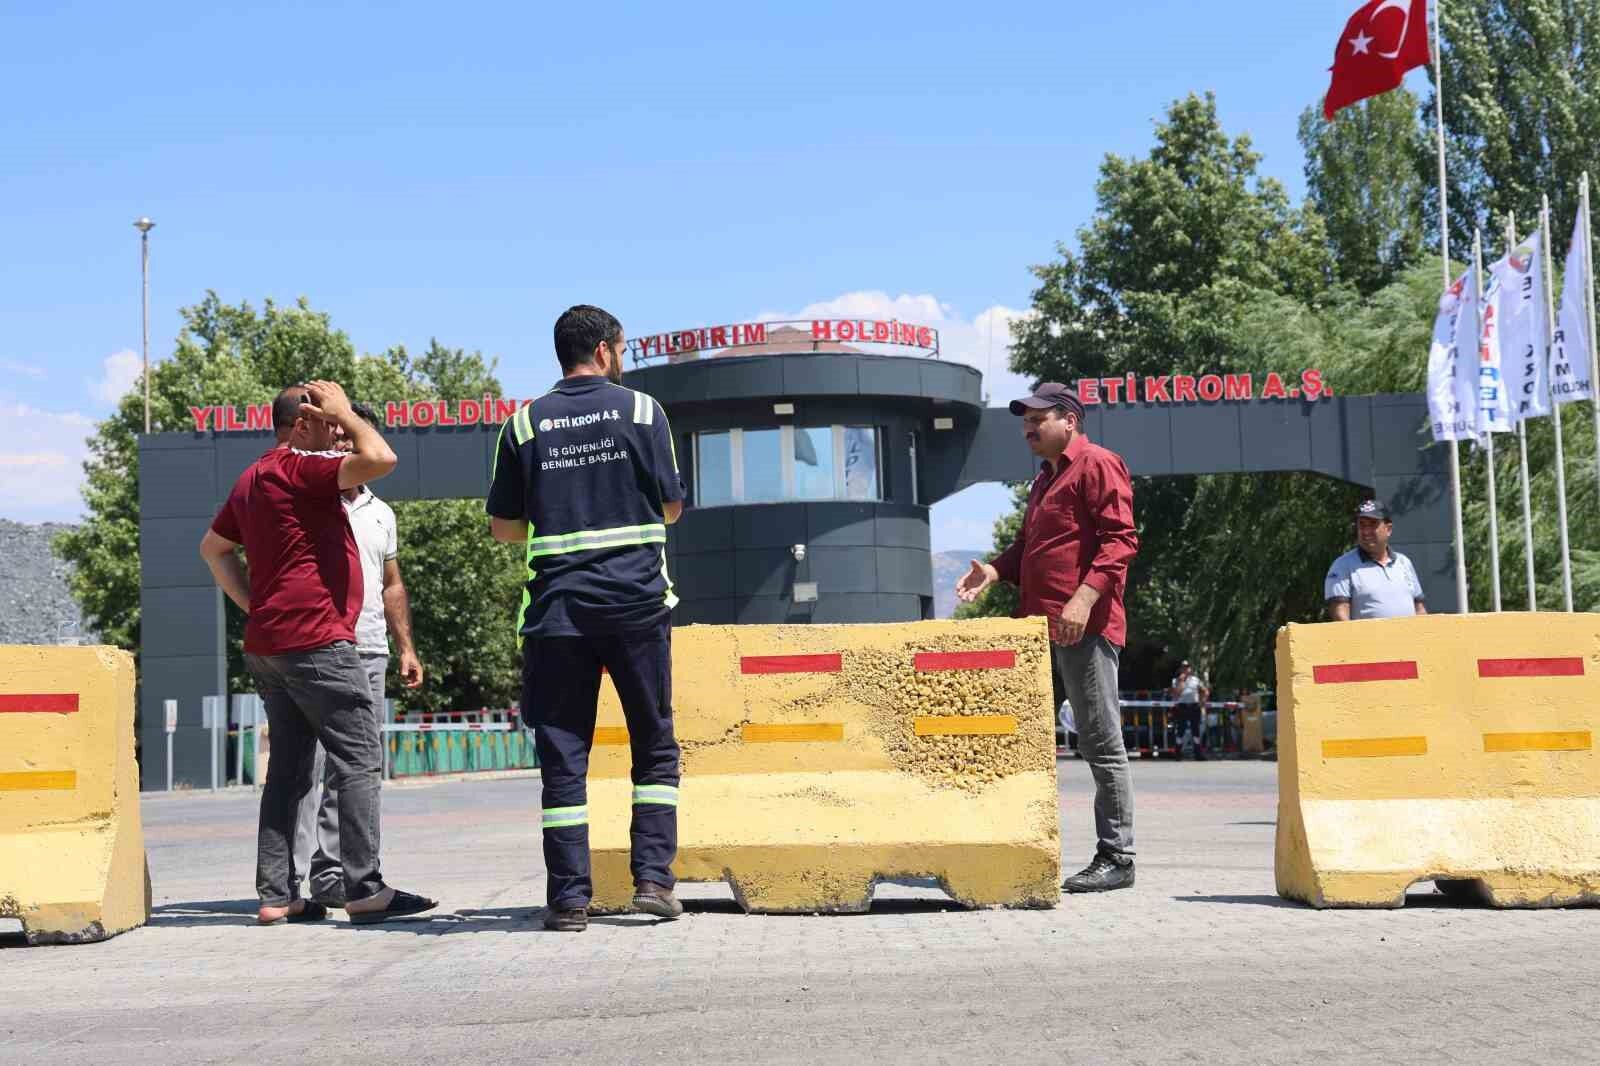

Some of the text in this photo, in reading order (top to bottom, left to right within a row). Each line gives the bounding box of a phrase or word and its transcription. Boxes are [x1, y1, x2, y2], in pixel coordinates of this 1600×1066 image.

[638, 318, 932, 358] YILDIRIM HOLDİNG
[1077, 368, 1334, 404] ETİ KROM A.Ş.
[386, 392, 534, 428] HOLDİN
[553, 416, 571, 429] ETİ
[571, 412, 601, 427] KROM
[541, 450, 629, 471] BENİMLE BAŞLAR
[549, 437, 615, 458] İŞ GÜVENLİĞİ
